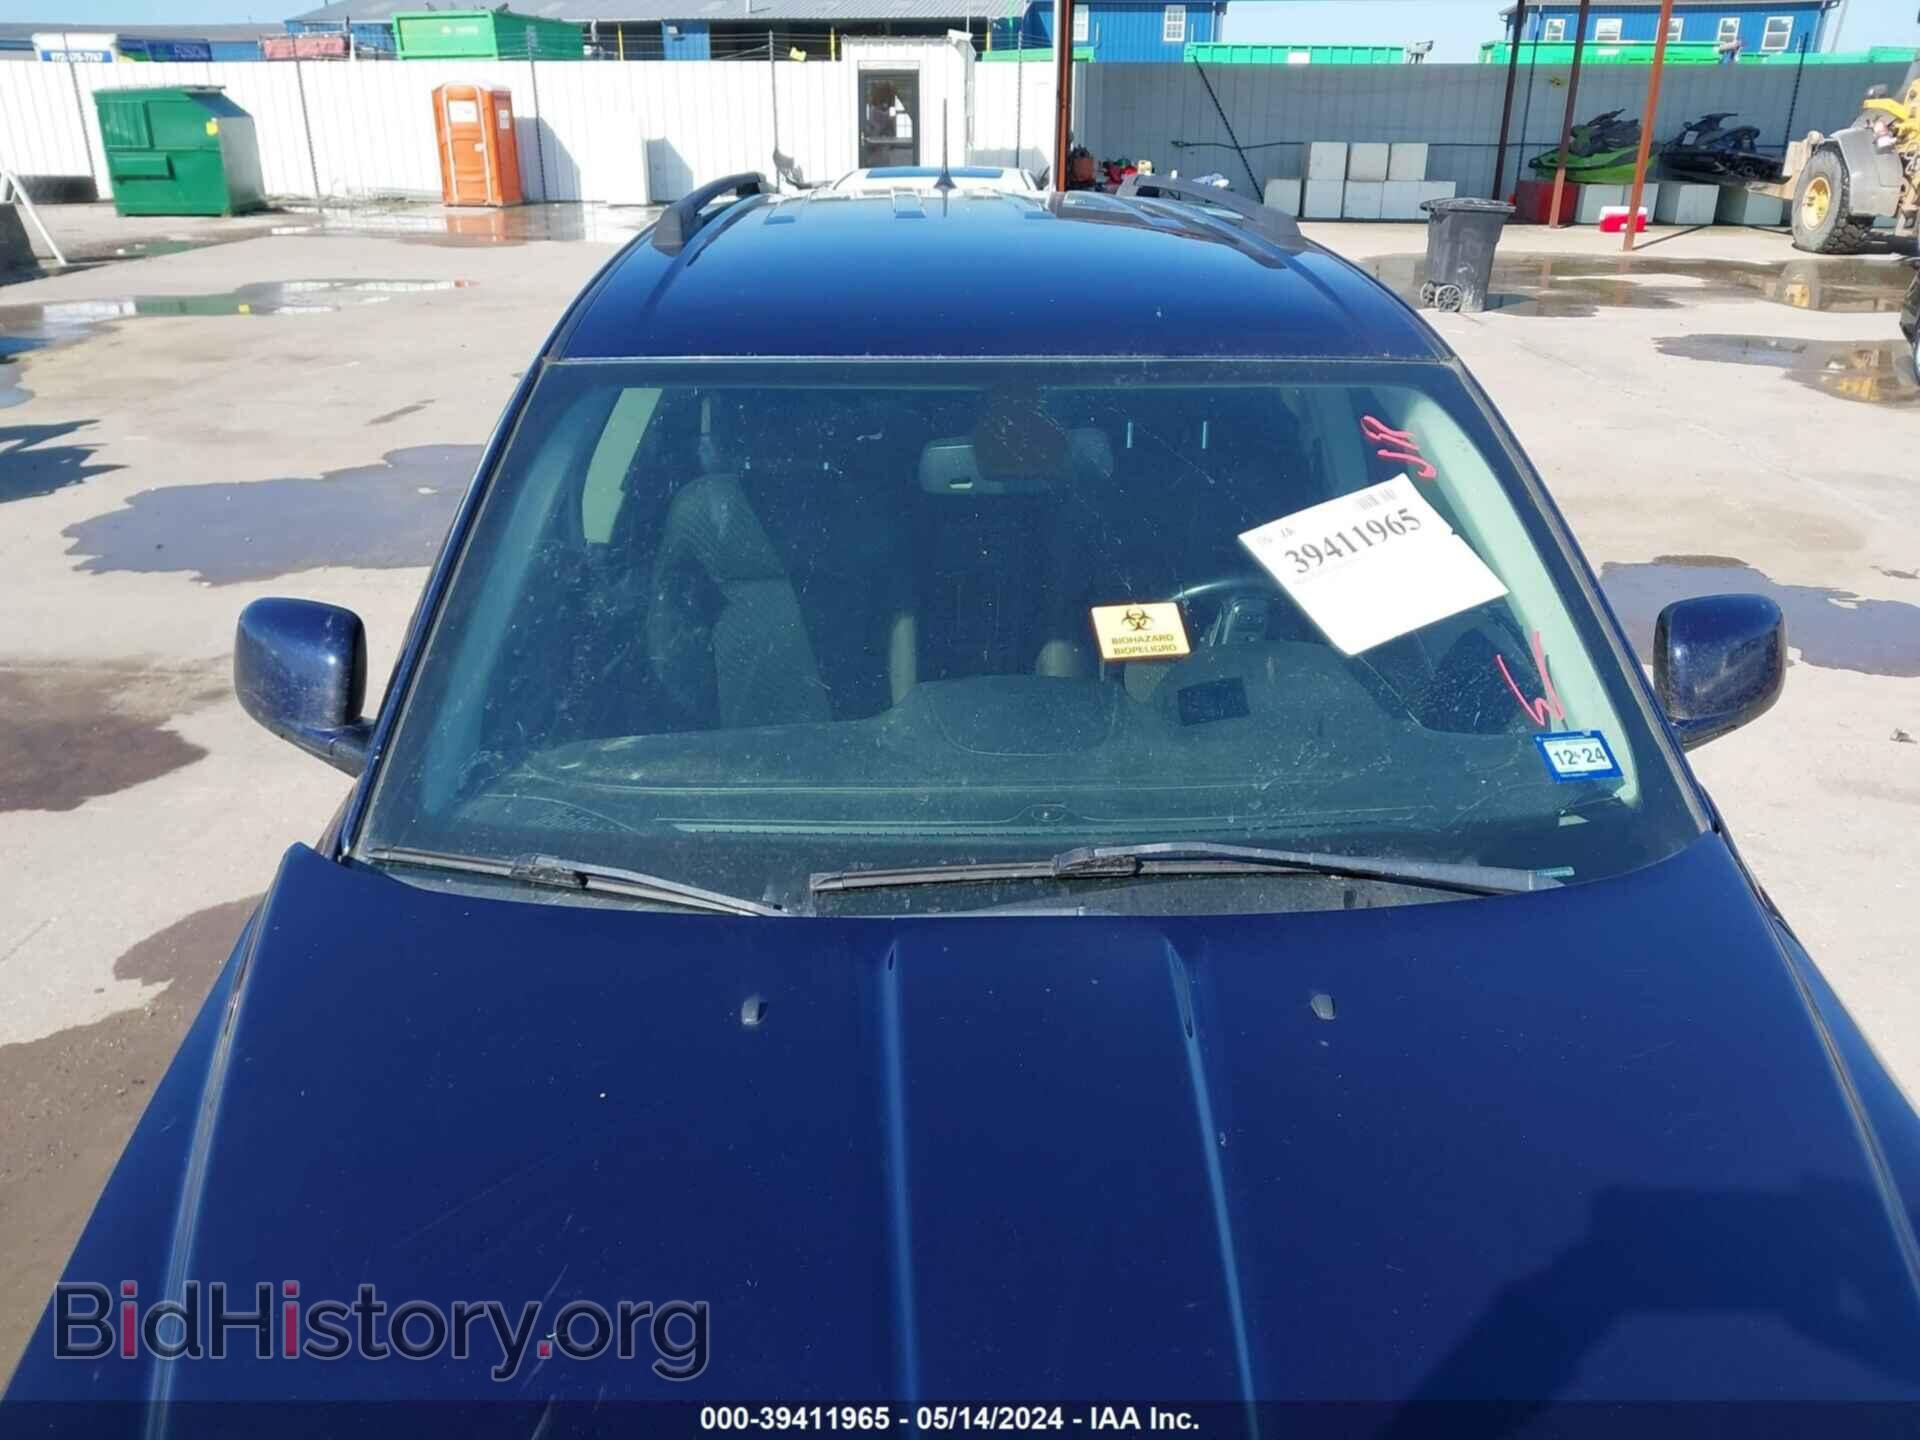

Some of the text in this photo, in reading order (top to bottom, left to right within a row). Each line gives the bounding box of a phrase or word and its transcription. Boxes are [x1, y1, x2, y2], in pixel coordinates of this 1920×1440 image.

[1284, 507, 1422, 574] 39411965
[1111, 633, 1175, 645] BIOHAZARD
[1113, 644, 1178, 655] BIOPELIGRO
